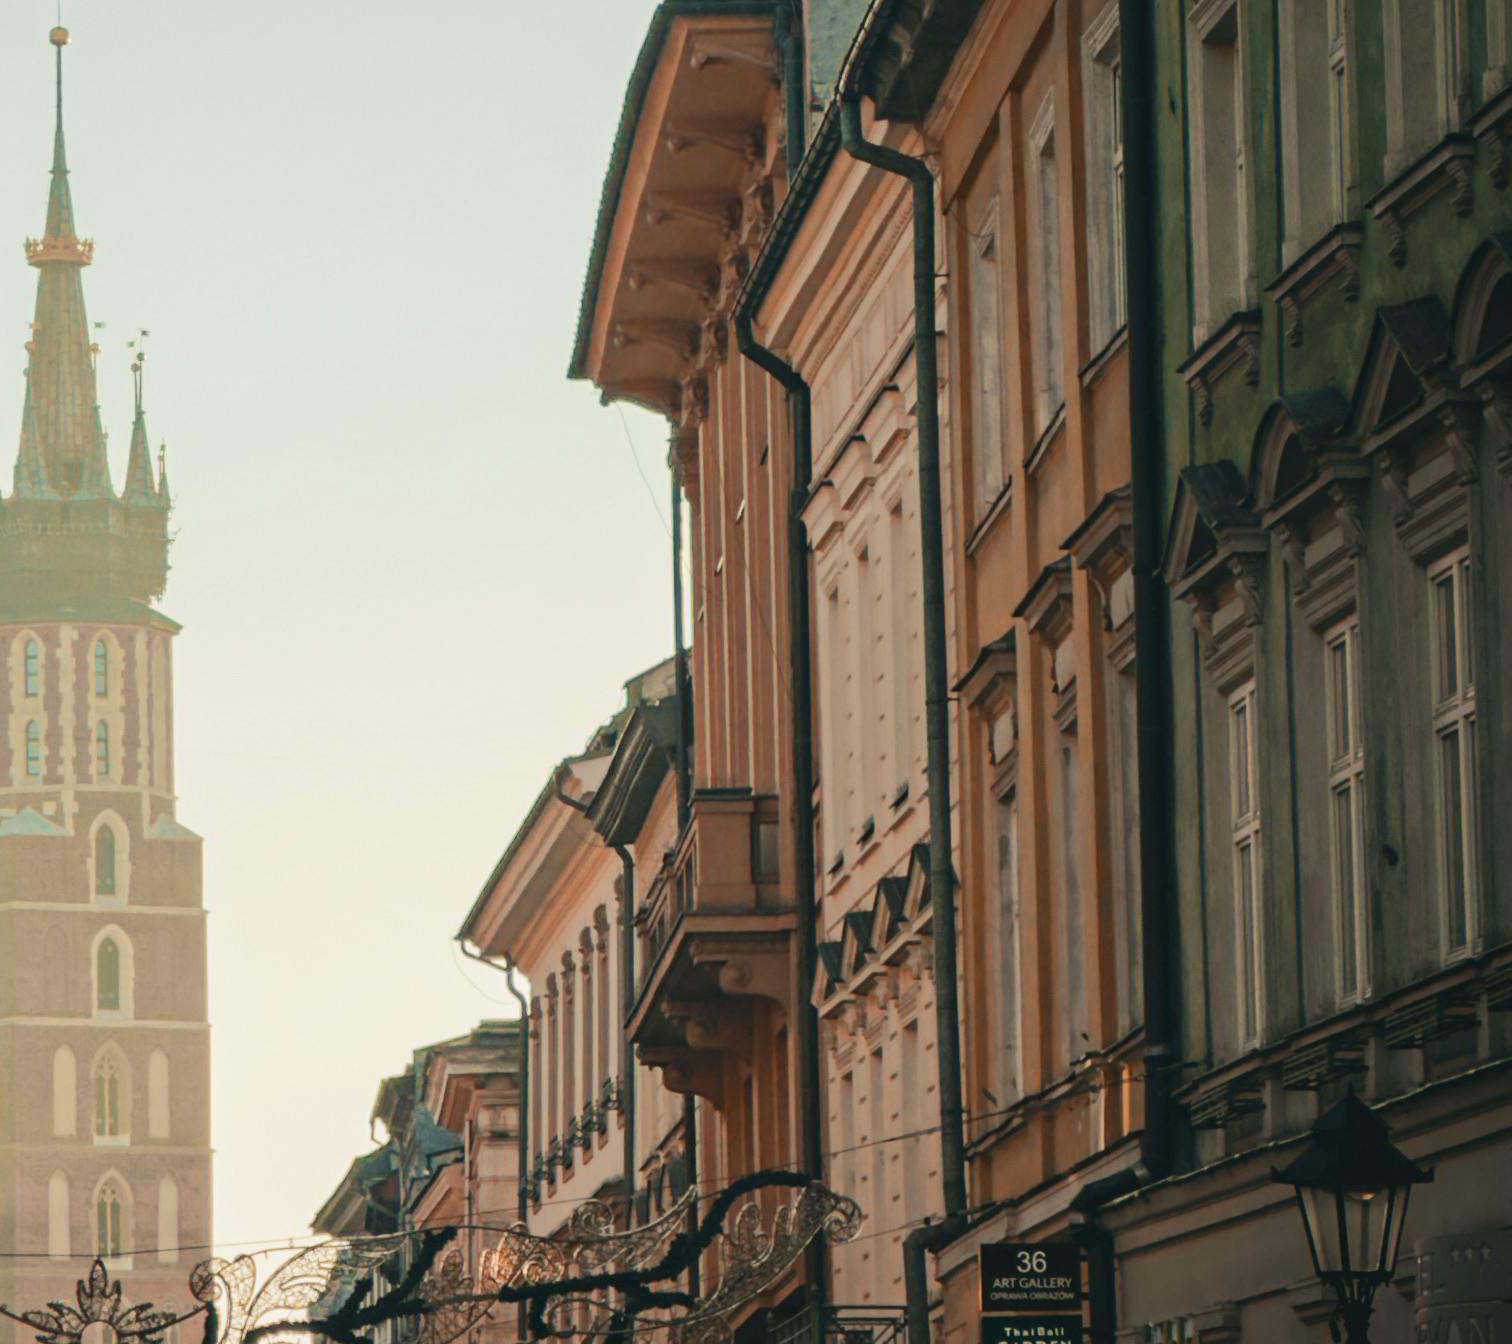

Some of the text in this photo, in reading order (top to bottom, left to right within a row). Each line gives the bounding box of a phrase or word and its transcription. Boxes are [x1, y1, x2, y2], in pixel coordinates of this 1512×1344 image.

[1016, 1250, 1047, 1273] 36
[992, 1277, 1073, 1289] ART GALLERY
